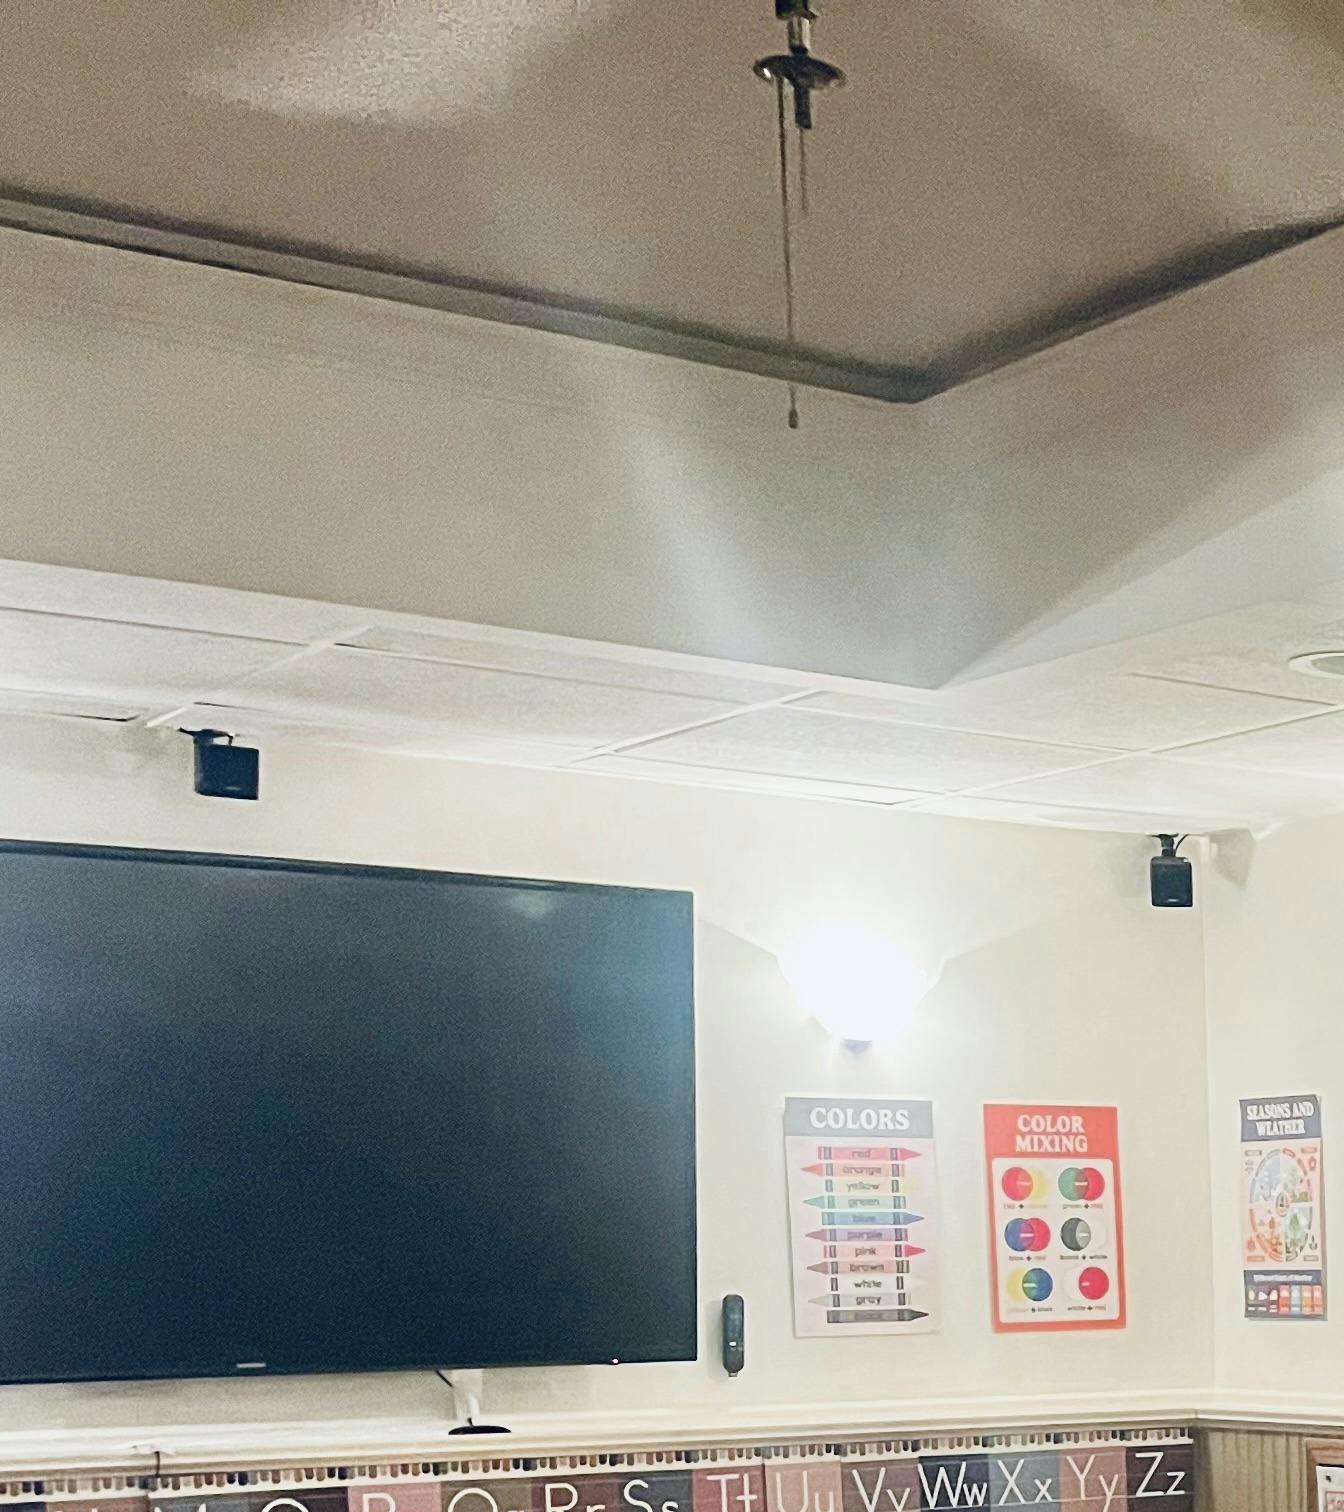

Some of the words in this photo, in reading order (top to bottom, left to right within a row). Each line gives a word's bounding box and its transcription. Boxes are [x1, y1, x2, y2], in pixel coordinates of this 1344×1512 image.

[809, 1107, 911, 1130] COLORS
[1246, 1103, 1291, 1120] SEASONS
[1292, 1101, 1314, 1117] AND
[1017, 1114, 1085, 1133] COLOR
[1255, 1119, 1306, 1136] WEATHER
[1015, 1134, 1088, 1153] MIXING
[851, 1149, 871, 1158] red
[846, 1181, 880, 1192] yellow
[854, 1247, 877, 1257] pink
[850, 1263, 884, 1272] brown
[853, 1279, 882, 1288] white
[918, 1462, 988, 1509] Ww
[997, 1458, 1054, 1506] Xx
[1135, 1451, 1187, 1498] Zz
